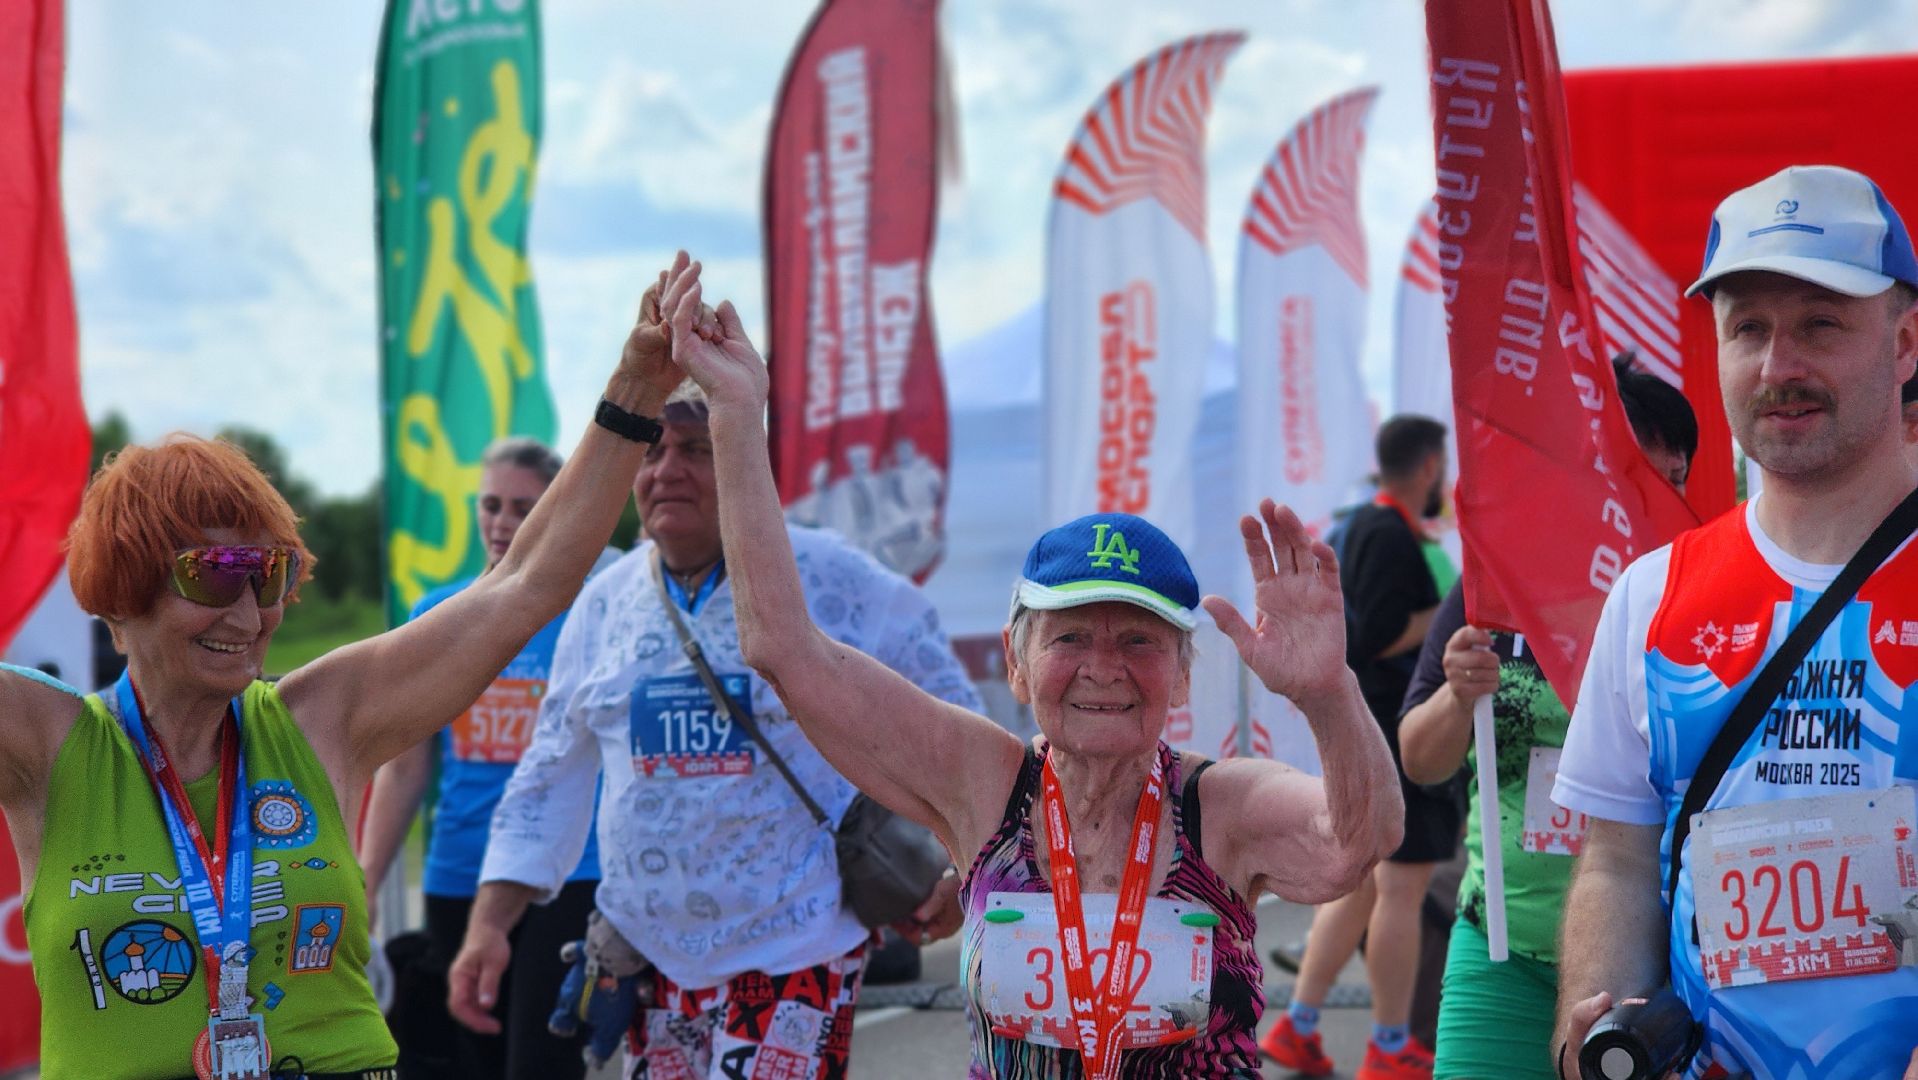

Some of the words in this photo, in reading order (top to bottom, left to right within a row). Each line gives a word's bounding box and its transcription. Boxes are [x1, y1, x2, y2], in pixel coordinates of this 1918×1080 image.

[1122, 340, 1157, 515] СПОРТ
[1087, 523, 1142, 575] LA
[1779, 659, 1868, 701] ЫЖНЯ
[470, 702, 536, 744] 5127
[657, 709, 733, 752] 1159
[1760, 707, 1861, 751] РОССИИ
[1755, 760, 1813, 785] МОСКВА
[1820, 762, 1861, 786] 2025
[70, 860, 281, 899] NEVR
[186, 879, 212, 902] 10
[1721, 855, 1871, 942] 3204
